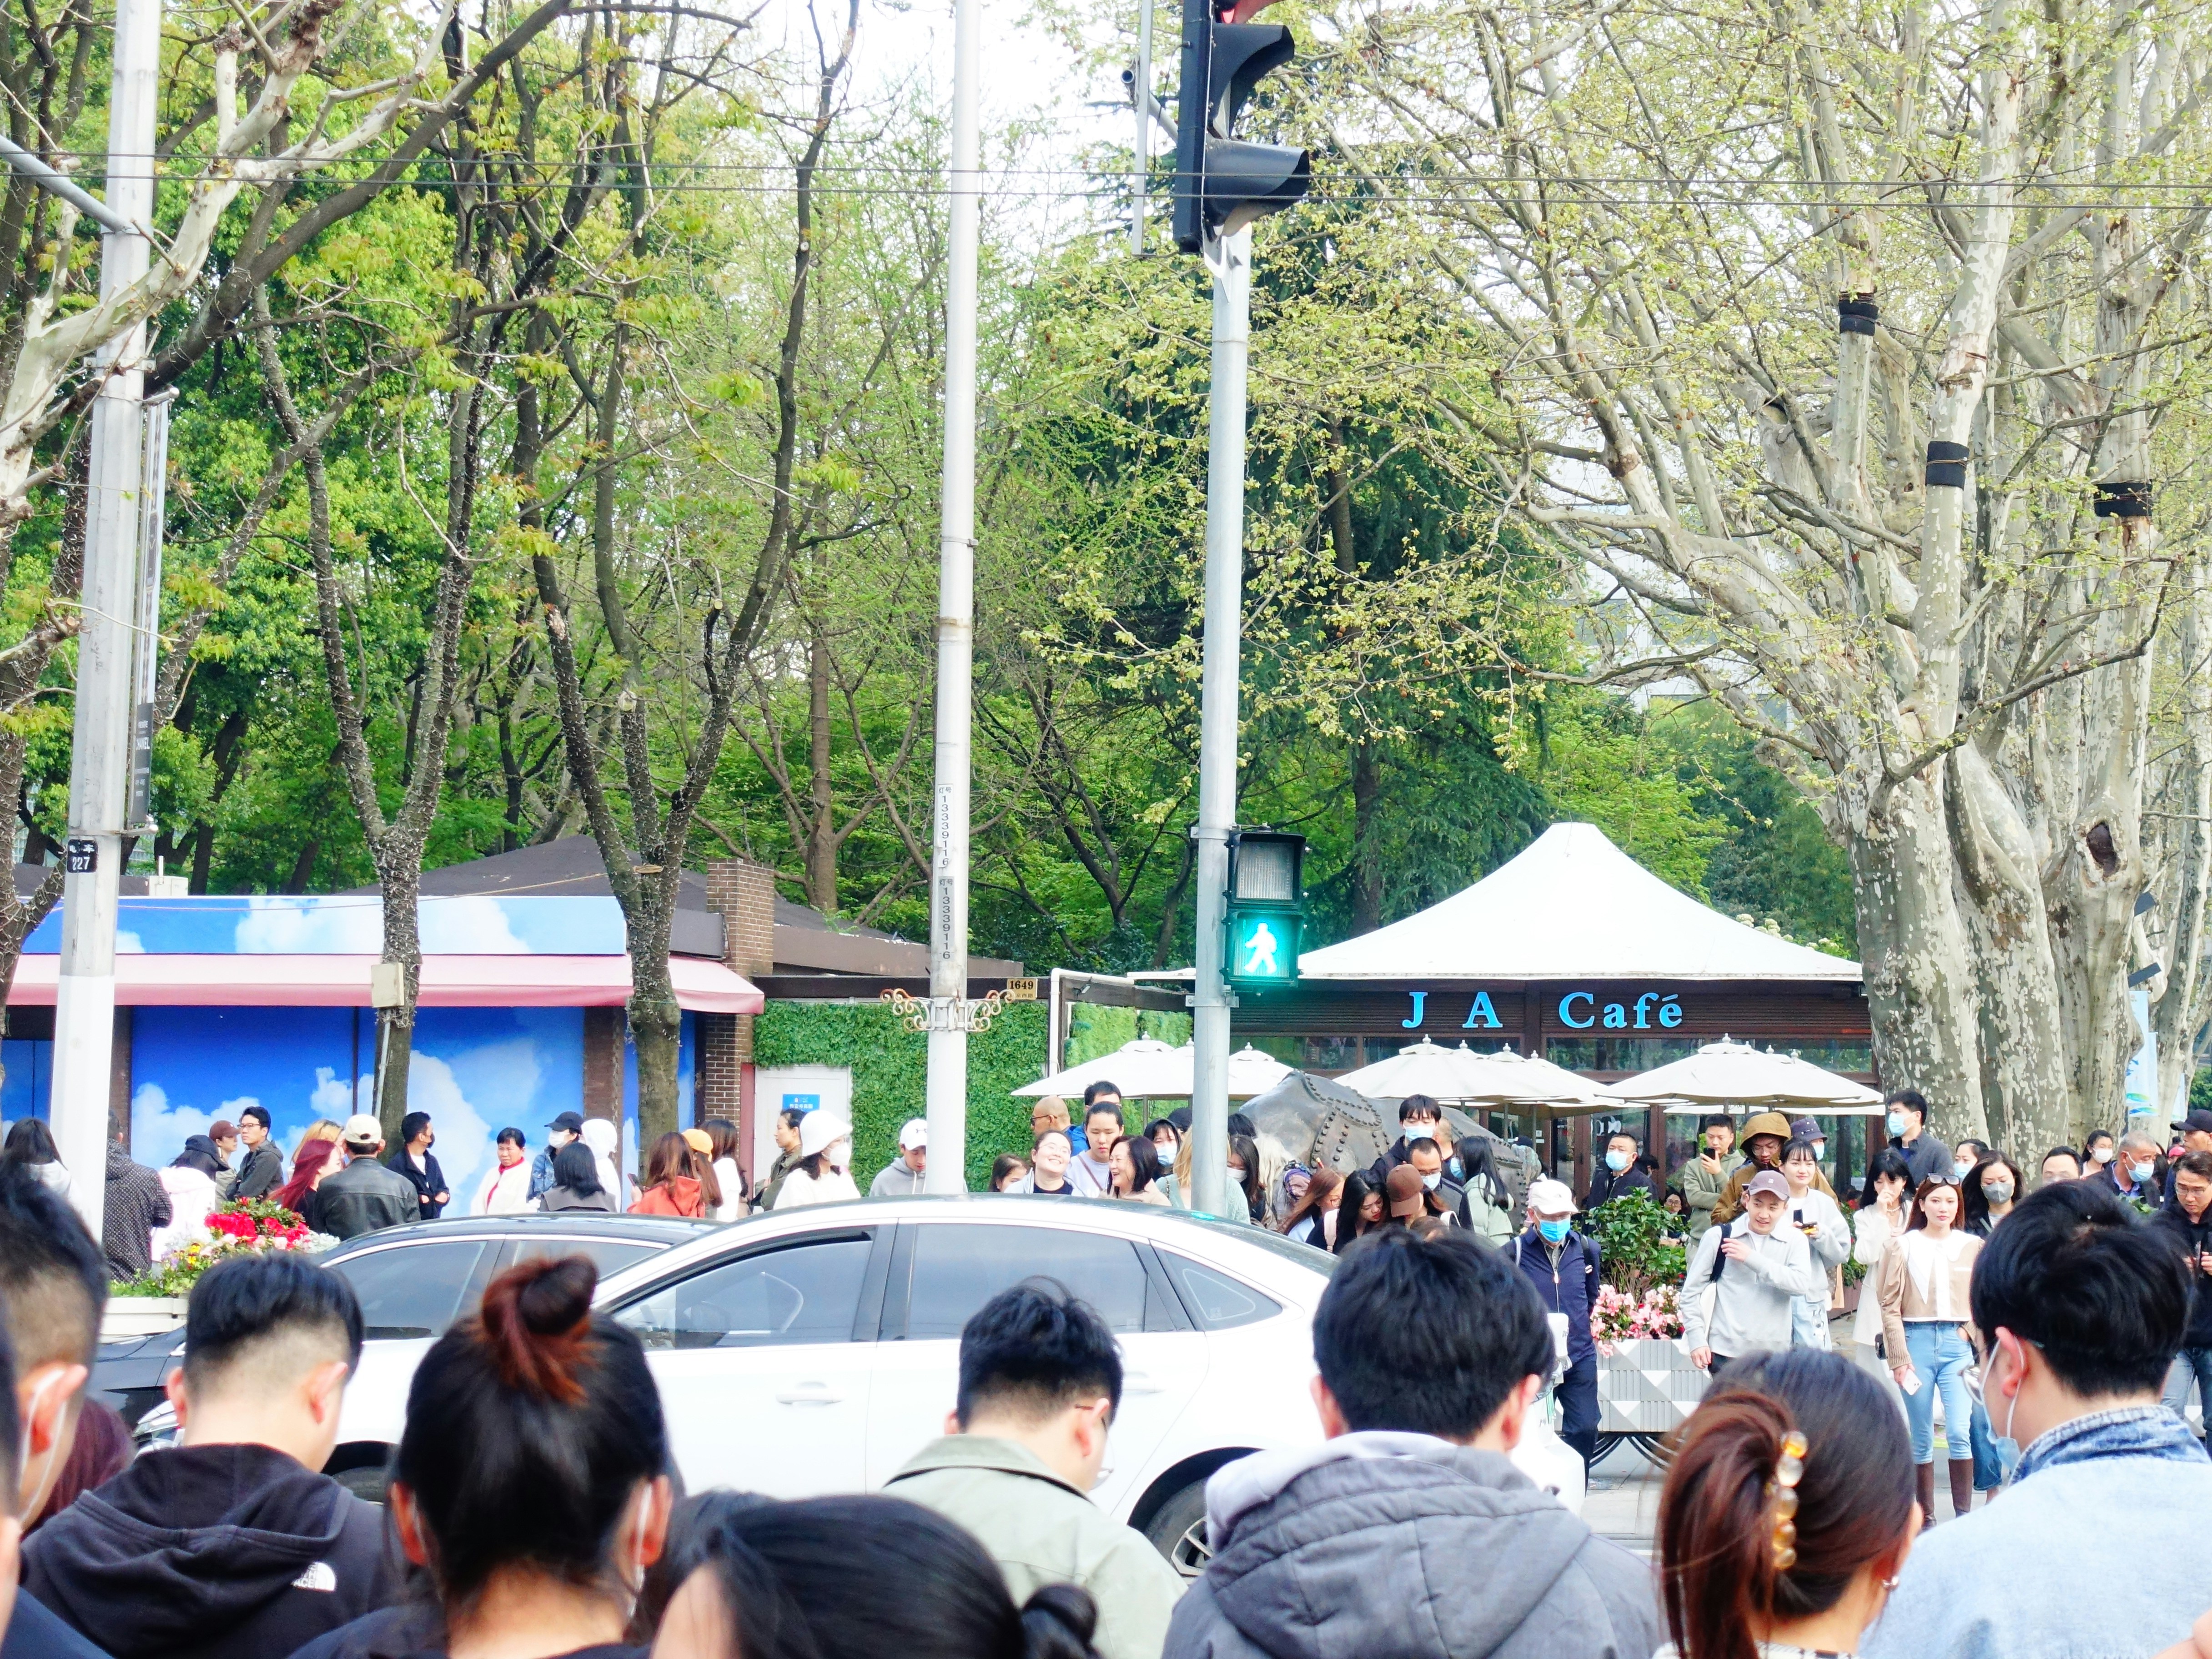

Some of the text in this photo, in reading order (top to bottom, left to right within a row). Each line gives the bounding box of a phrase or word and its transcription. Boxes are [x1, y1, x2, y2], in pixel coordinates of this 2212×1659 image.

[73, 856, 90, 870] 227
[942, 887, 950, 959] 13339116
[1010, 980, 1034, 990] 1649
[1559, 992, 1682, 1028] Café
